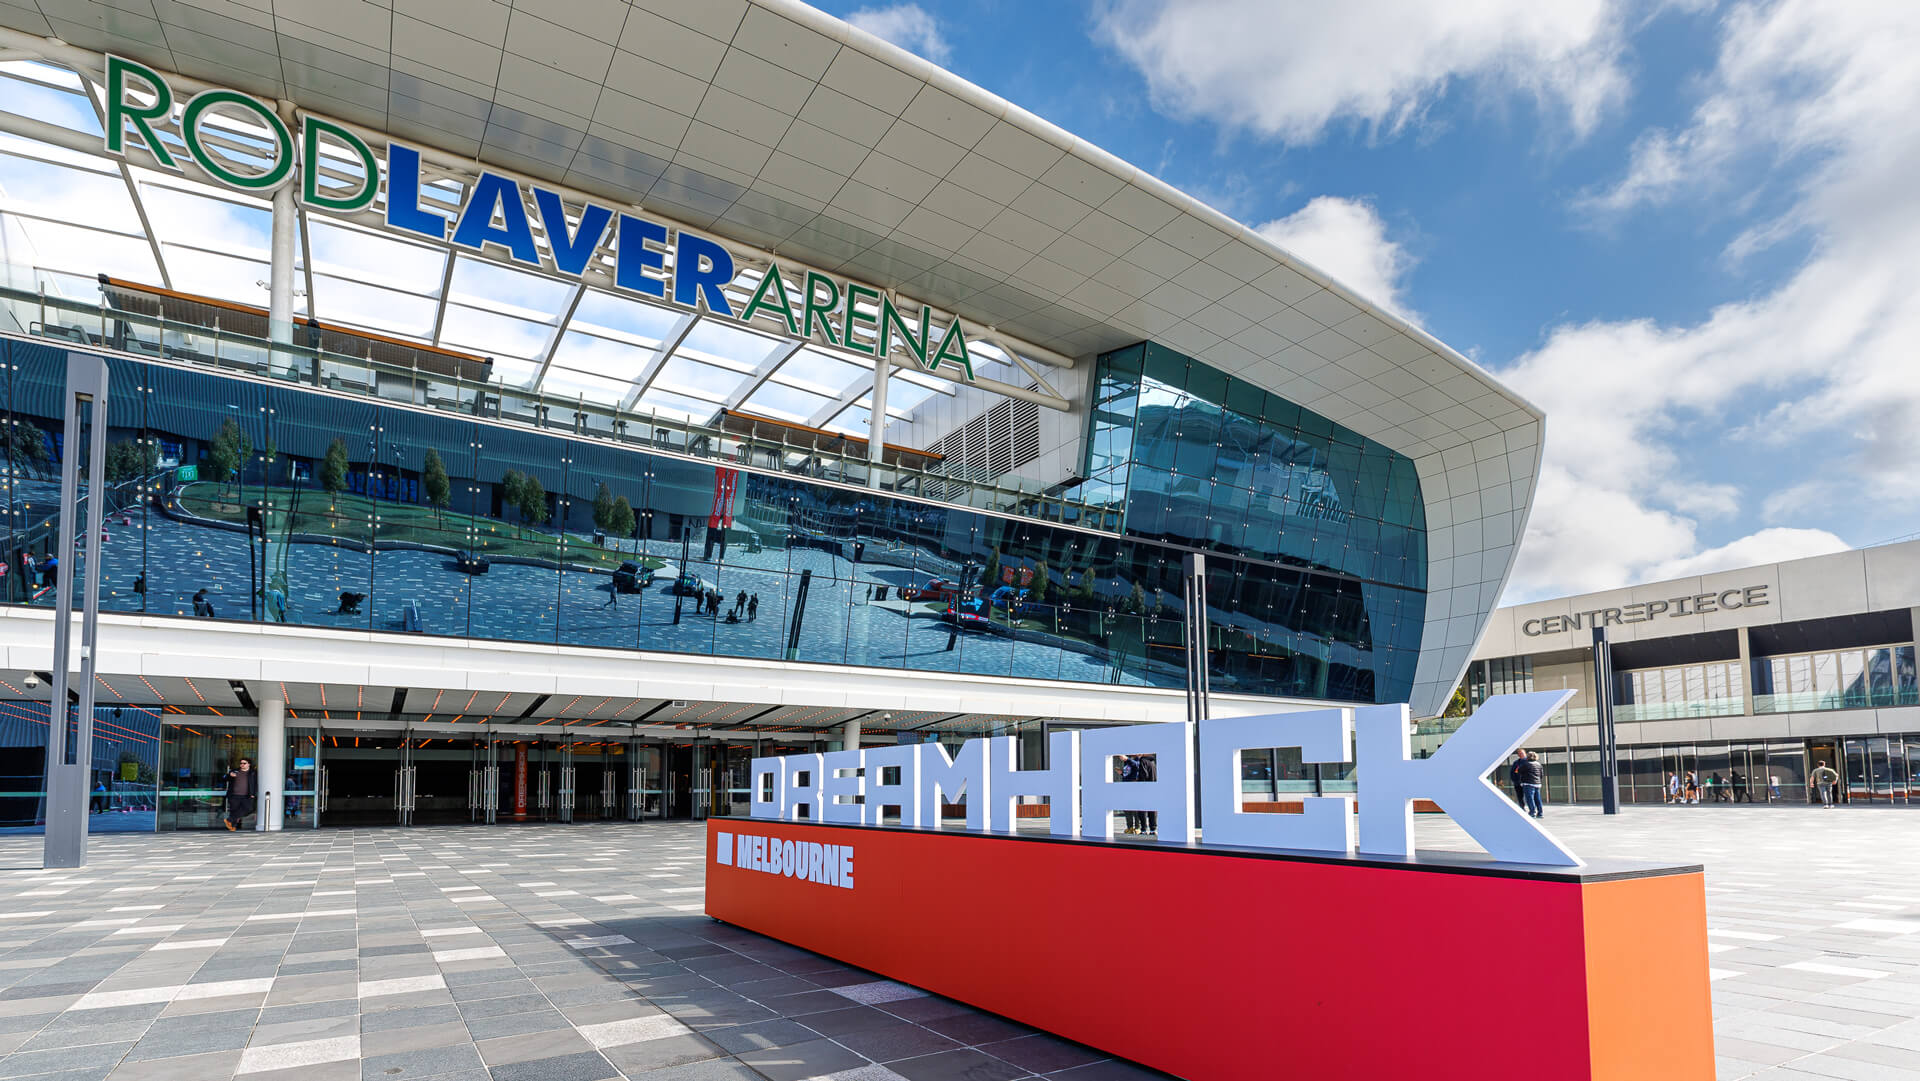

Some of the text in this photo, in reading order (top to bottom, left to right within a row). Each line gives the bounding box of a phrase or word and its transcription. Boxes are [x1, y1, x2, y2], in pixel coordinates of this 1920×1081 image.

[104, 53, 976, 384] ROD LAVER ARENA
[1522, 584, 1769, 637] CENTREPIECE
[750, 689, 1587, 867] DREAMHACK
[737, 834, 854, 889] MELBOURNE
